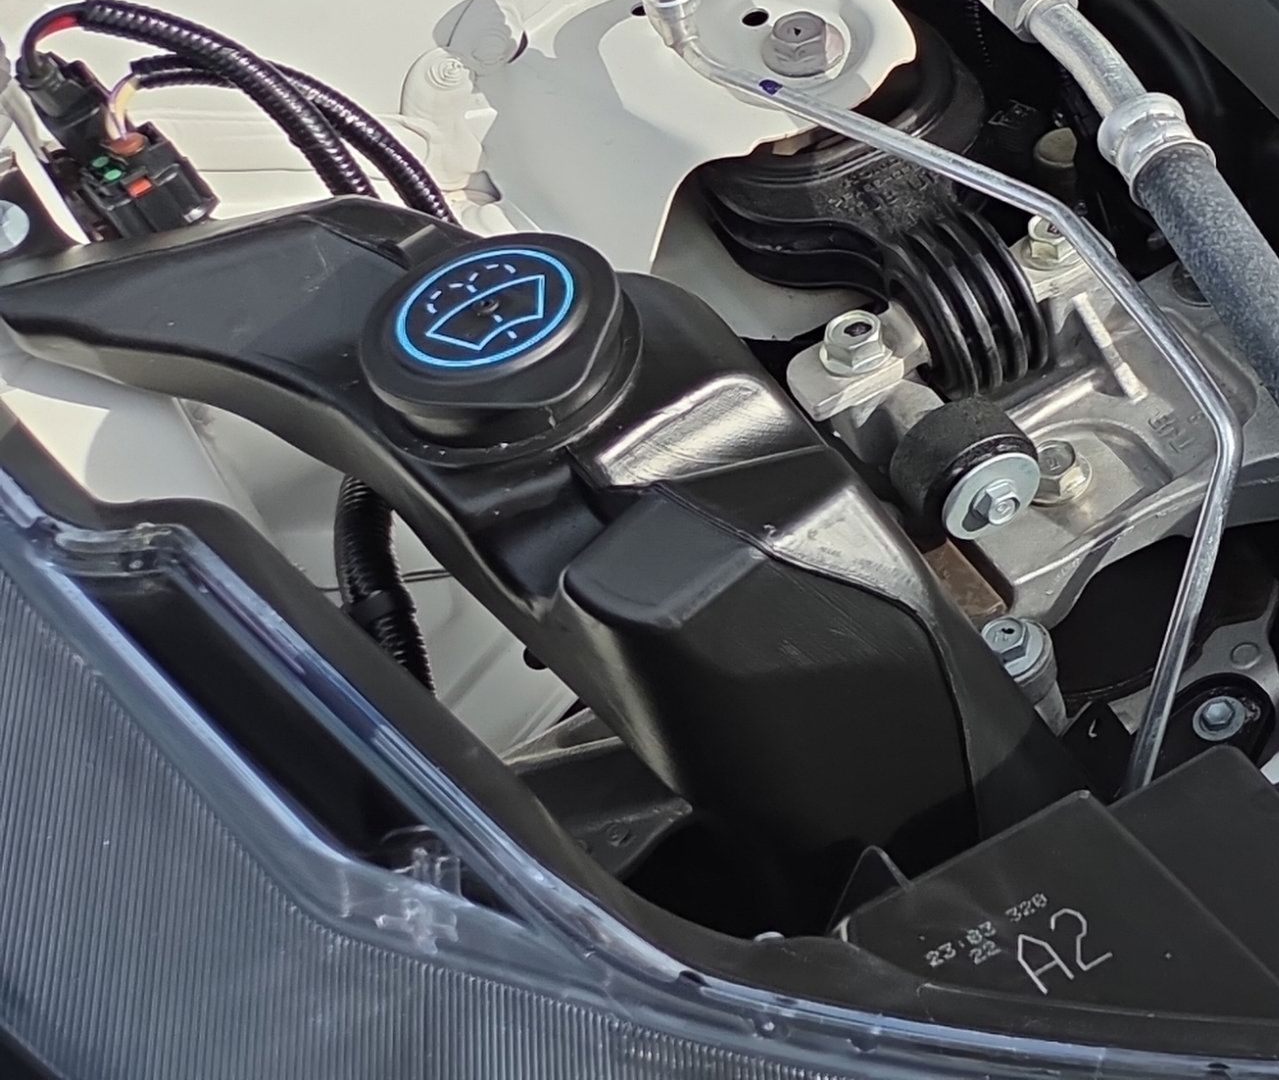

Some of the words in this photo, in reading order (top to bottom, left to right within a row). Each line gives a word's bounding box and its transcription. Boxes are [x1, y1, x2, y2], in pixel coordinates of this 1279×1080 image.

[1005, 893, 1048, 923] 320
[968, 940, 1003, 966] 22
[1018, 908, 1113, 995] A2
